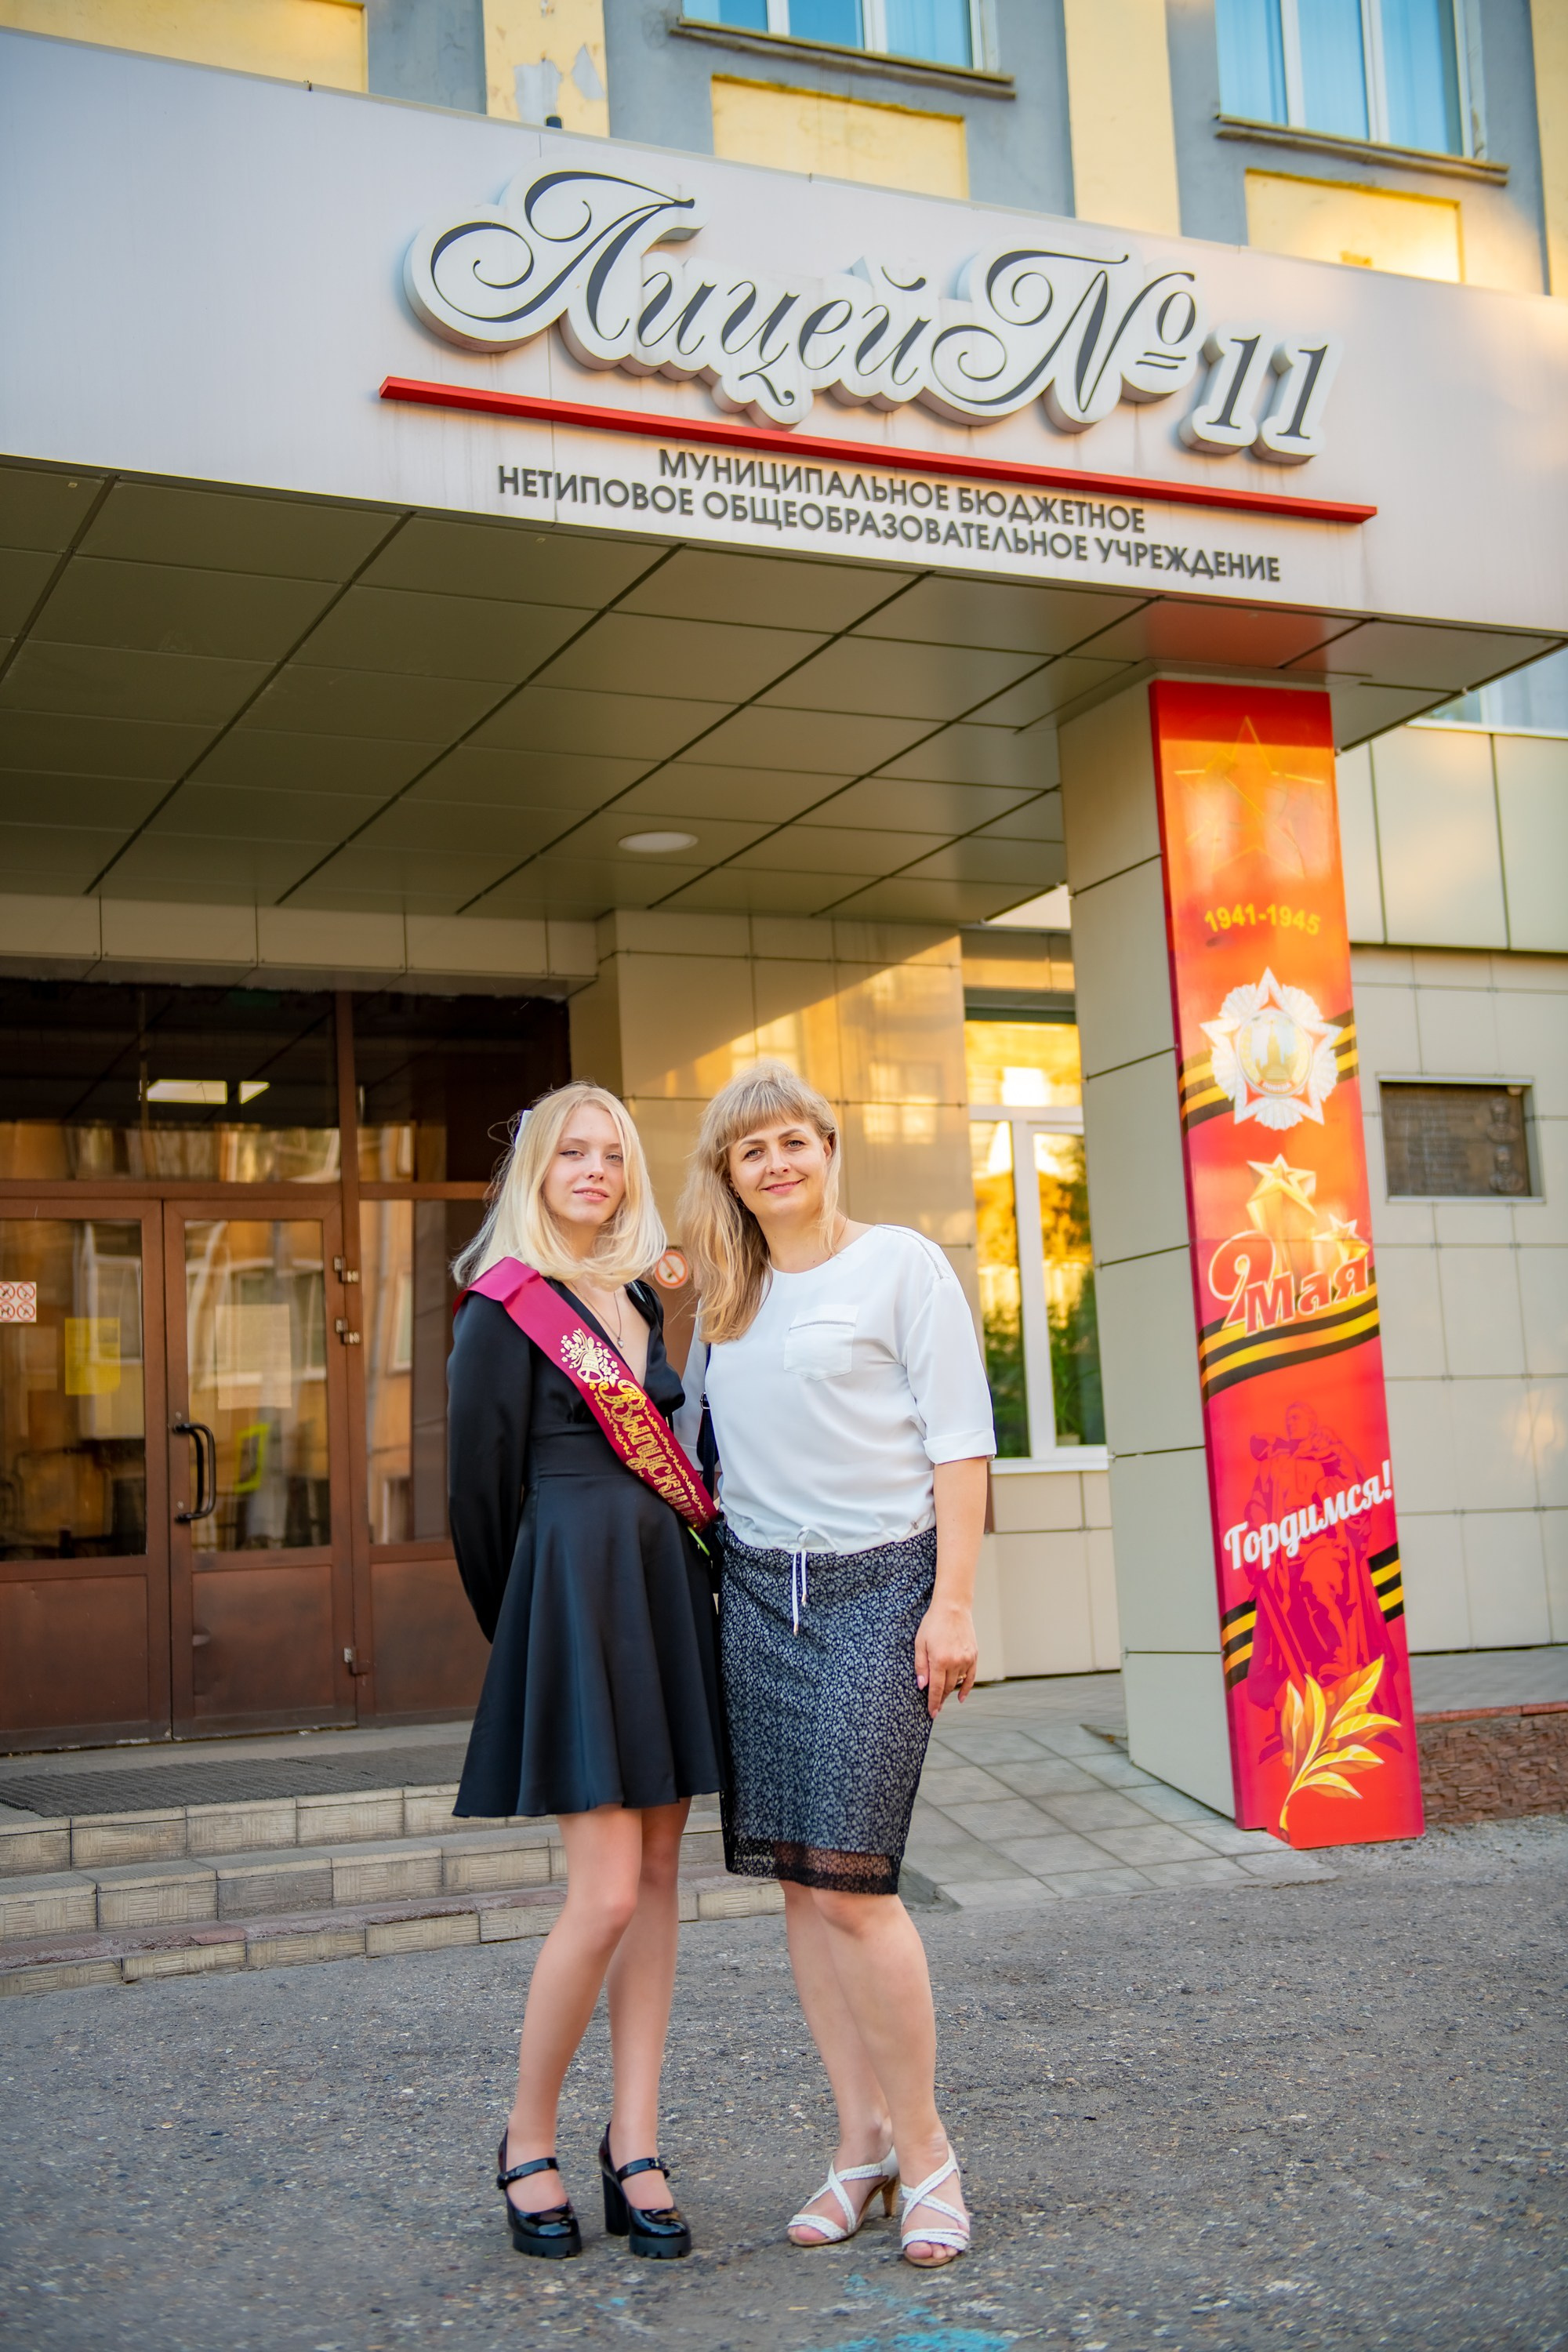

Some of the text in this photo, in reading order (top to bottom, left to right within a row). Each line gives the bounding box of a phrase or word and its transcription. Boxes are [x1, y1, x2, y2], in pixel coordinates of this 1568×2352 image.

[430, 170, 931, 405] Лицей
[499, 466, 1280, 583] НЕТИПОВОЕ ОБЩЕОБРАЗОВАТЕЛЬНОЕ УЧРЕЖДЕНИЕ
[659, 448, 1145, 534] МУНИЦИПАЛЬНОЕ БЮДЖЕТНОЕ
[1205, 903, 1320, 935] 1941-1945
[1208, 1229, 1276, 1330] 9
[598, 1379, 702, 1529] Выпускни
[1223, 1460, 1392, 1570] Гордимся!
